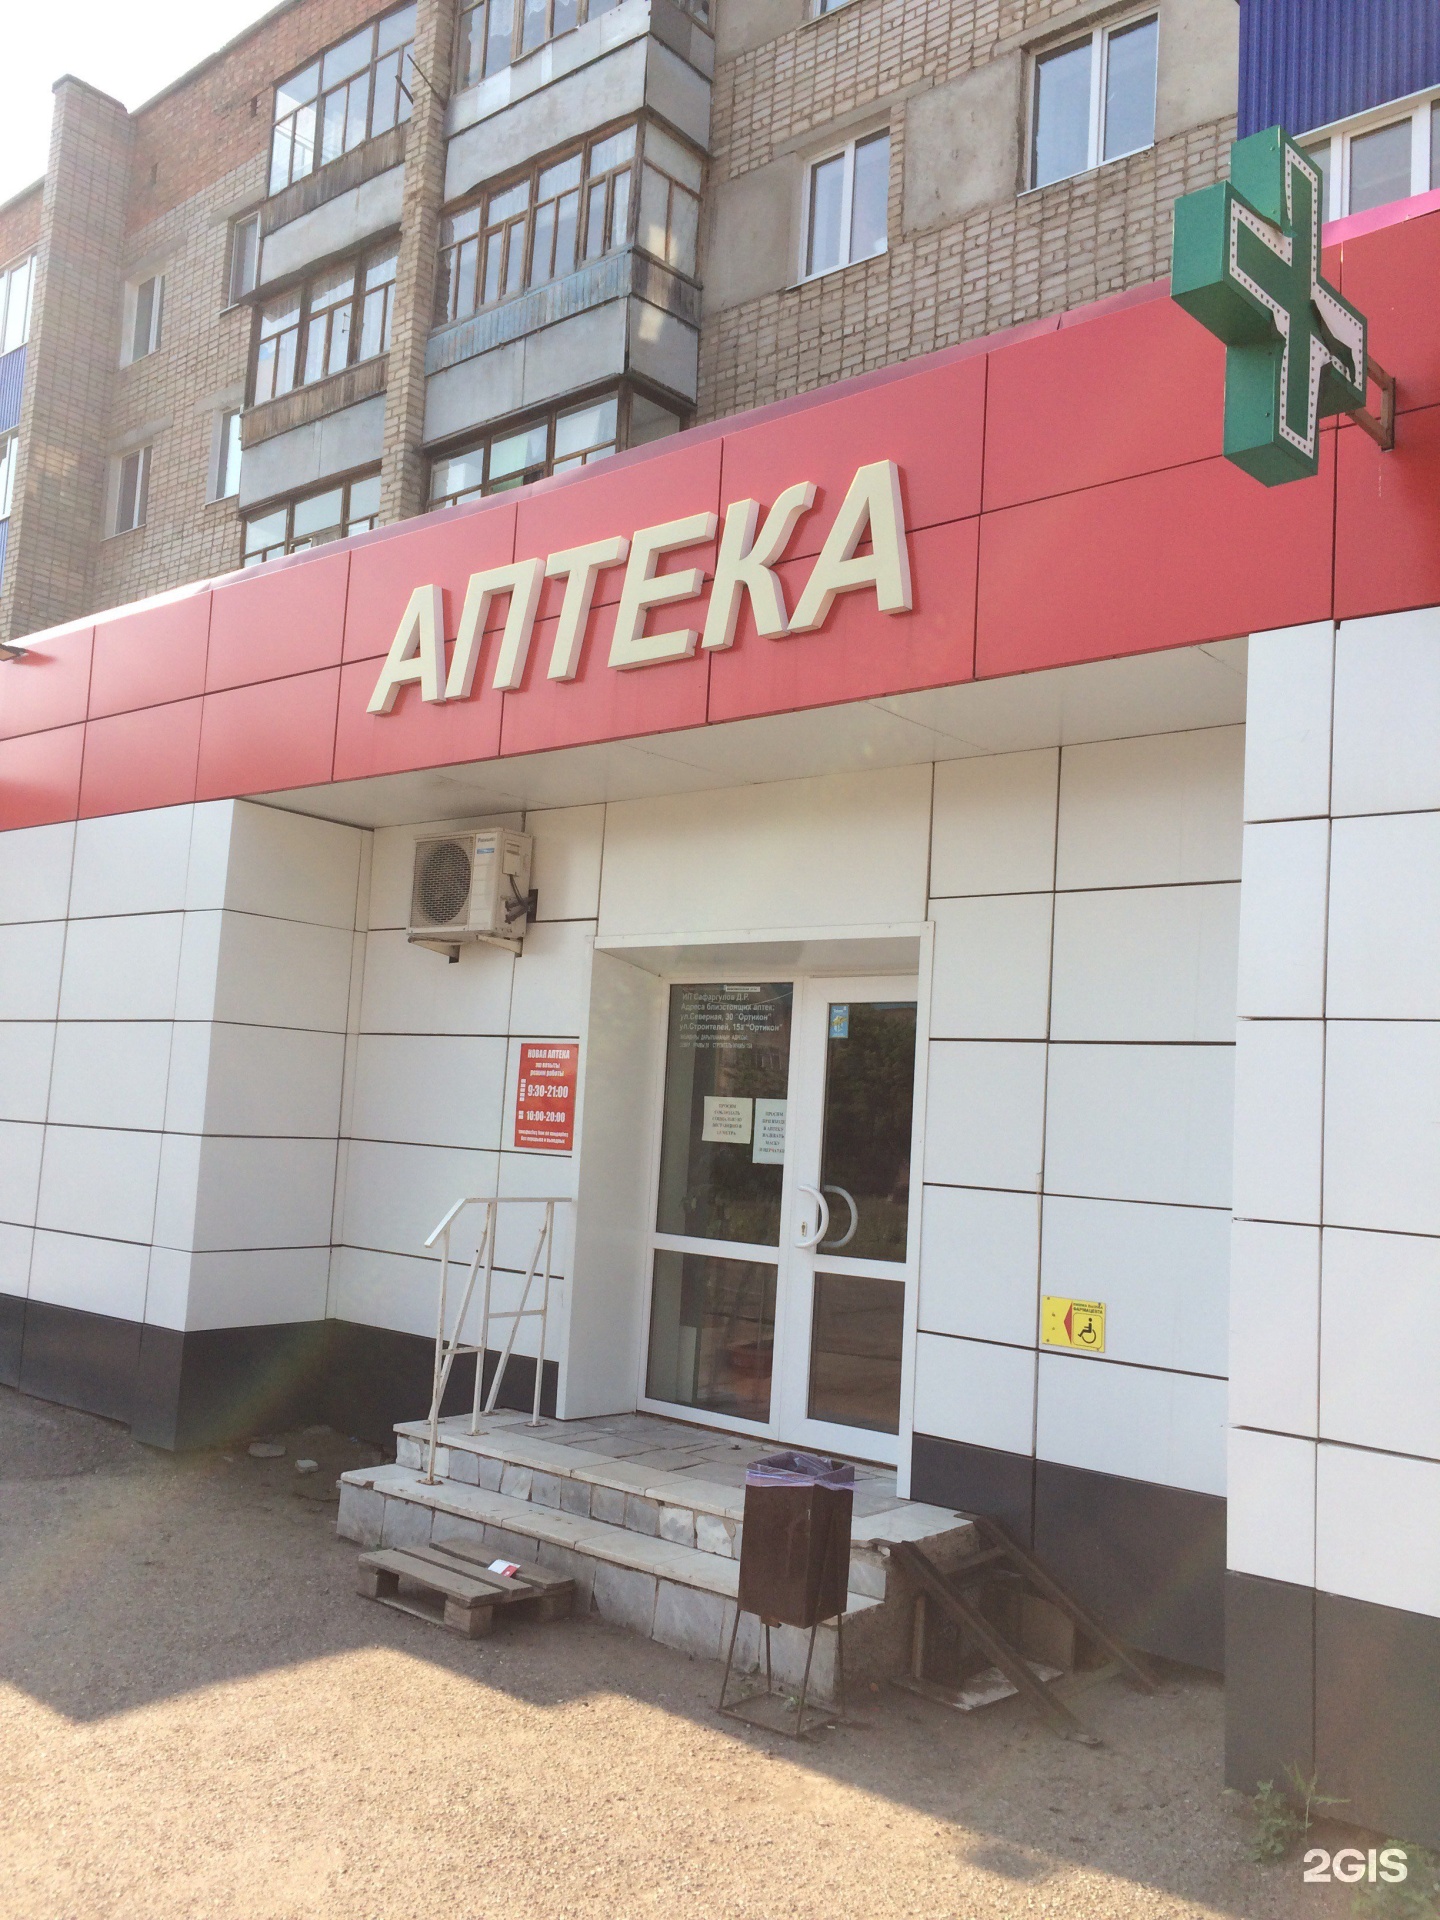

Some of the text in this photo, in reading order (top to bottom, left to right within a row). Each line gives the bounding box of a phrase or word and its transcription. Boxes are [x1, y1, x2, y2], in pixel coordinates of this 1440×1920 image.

[366, 459, 912, 715] АПТЕКА
[681, 1003, 705, 1011] Адреса
[528, 1049, 570, 1059] НОВАЯ АПТЕКА
[528, 1084, 568, 1098] 9:30-21:00
[526, 1110, 565, 1122] 10:00-20:00
